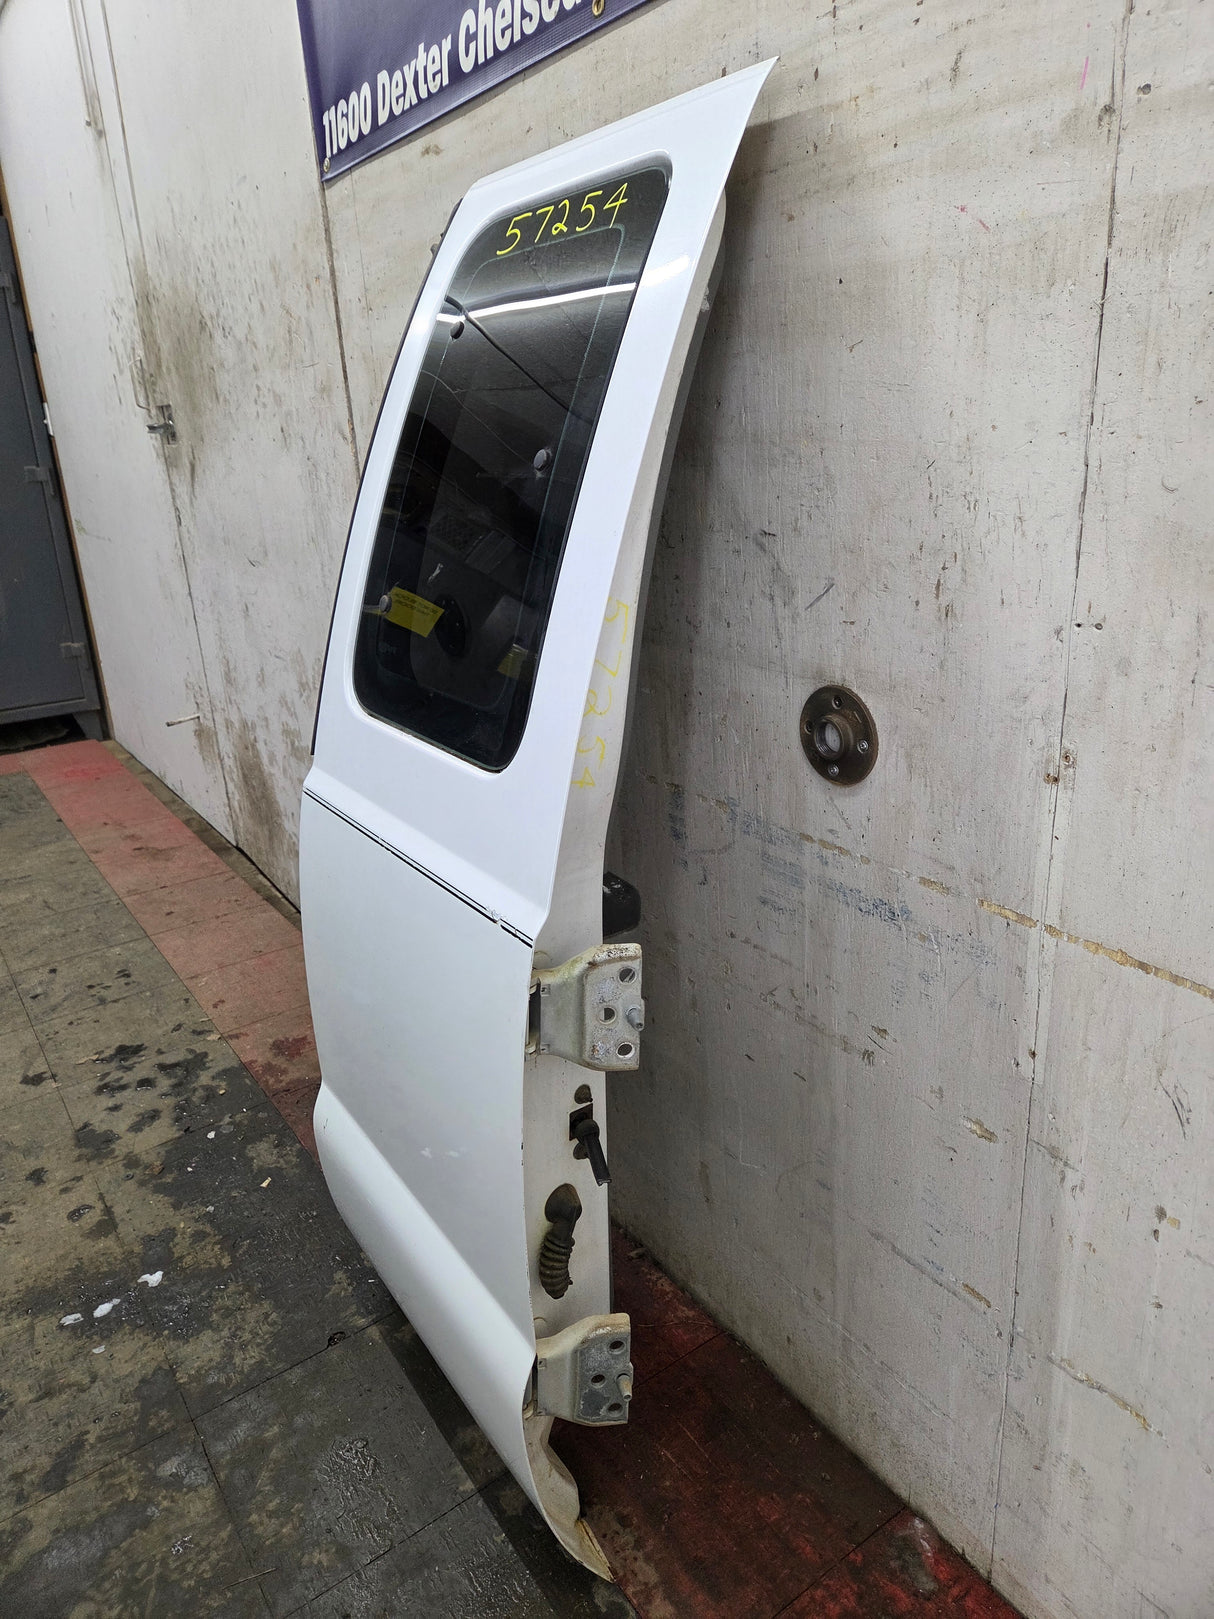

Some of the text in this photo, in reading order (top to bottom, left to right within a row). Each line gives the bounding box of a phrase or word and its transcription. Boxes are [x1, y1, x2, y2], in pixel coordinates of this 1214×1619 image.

[322, 0, 581, 158] 11600 Dexter Chels
[496, 182, 628, 255] 57254
[571, 596, 629, 788] 57254
